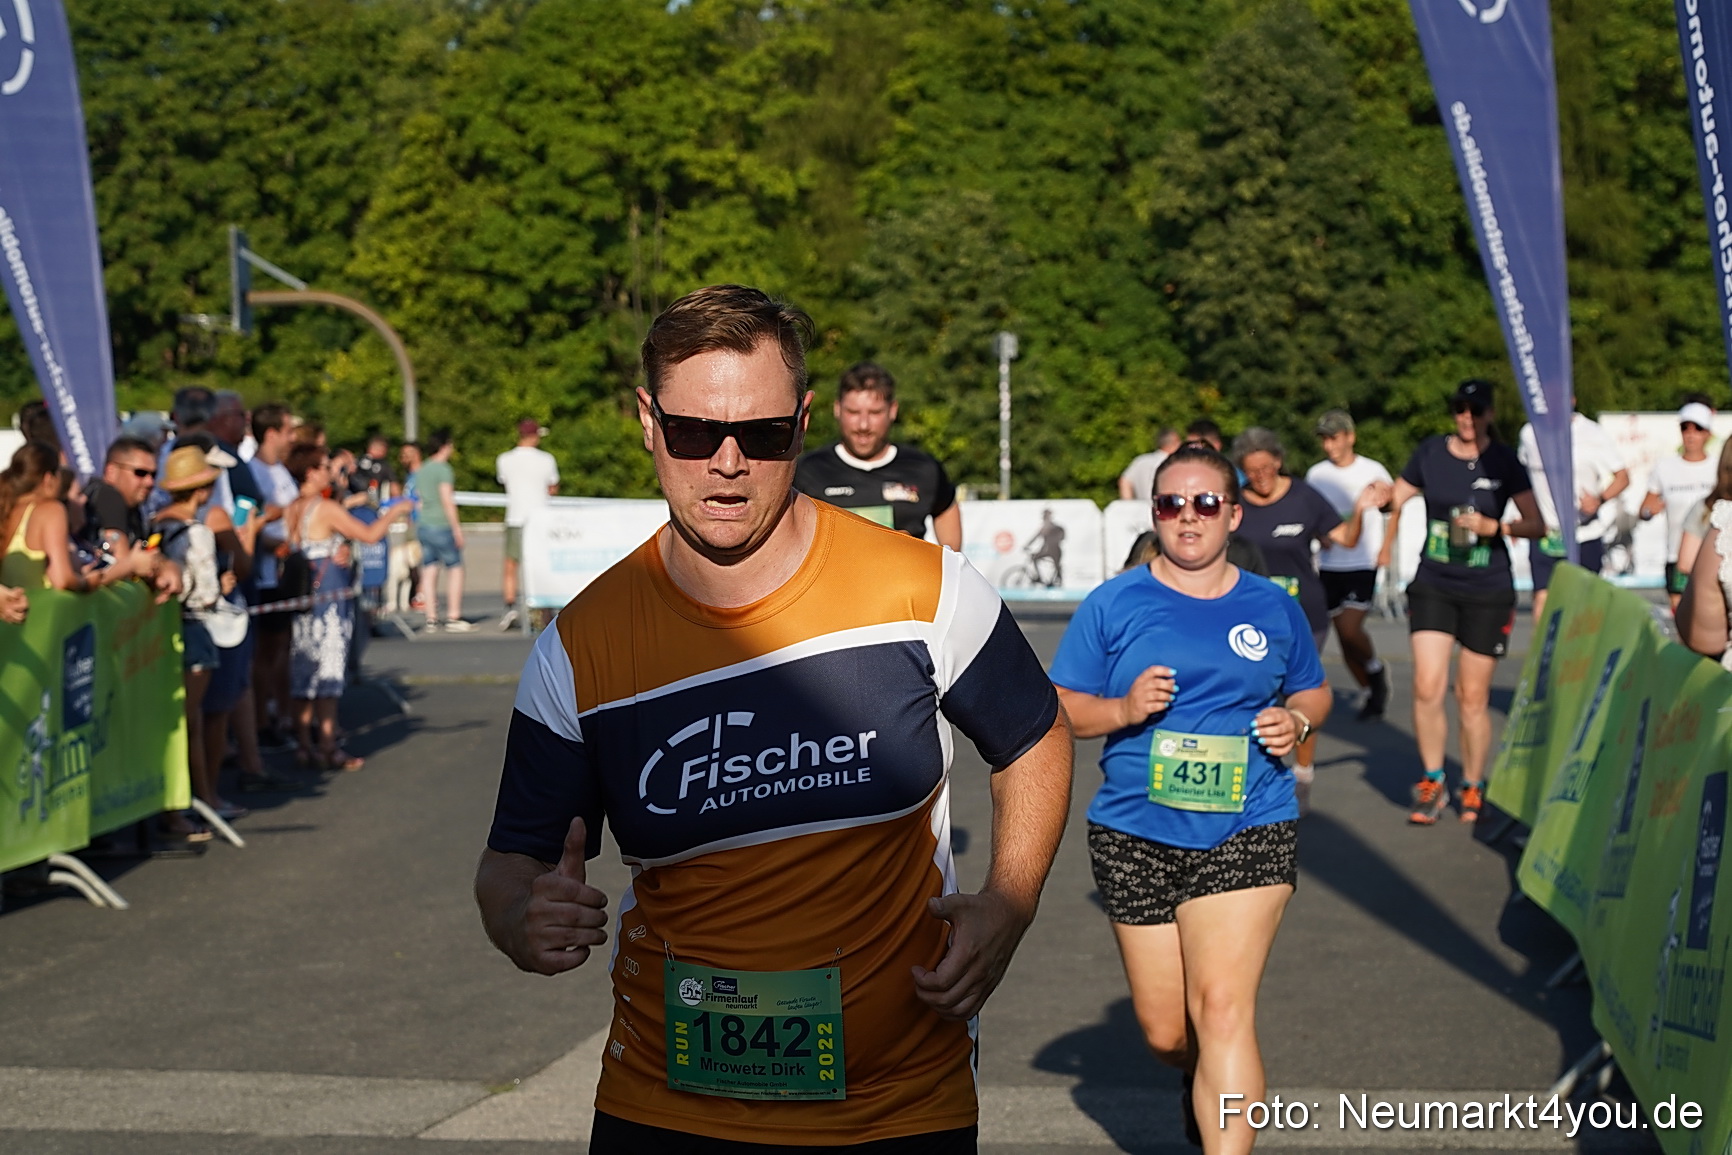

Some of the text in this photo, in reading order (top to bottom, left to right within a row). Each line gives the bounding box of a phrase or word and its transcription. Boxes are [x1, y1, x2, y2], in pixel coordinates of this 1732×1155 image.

[678, 729, 877, 801] Fischer
[1173, 760, 1222, 786] 431
[698, 766, 872, 815] AUTOMOBILE
[705, 993, 758, 1004] Firmenlauf
[610, 1039, 626, 1063] FIAT
[674, 1021, 689, 1066] RUN
[693, 1012, 812, 1058] 1842
[817, 1022, 835, 1081] 2022
[700, 1057, 806, 1076] Mrowetz Dirk
[716, 1078, 736, 1086] Fischer
